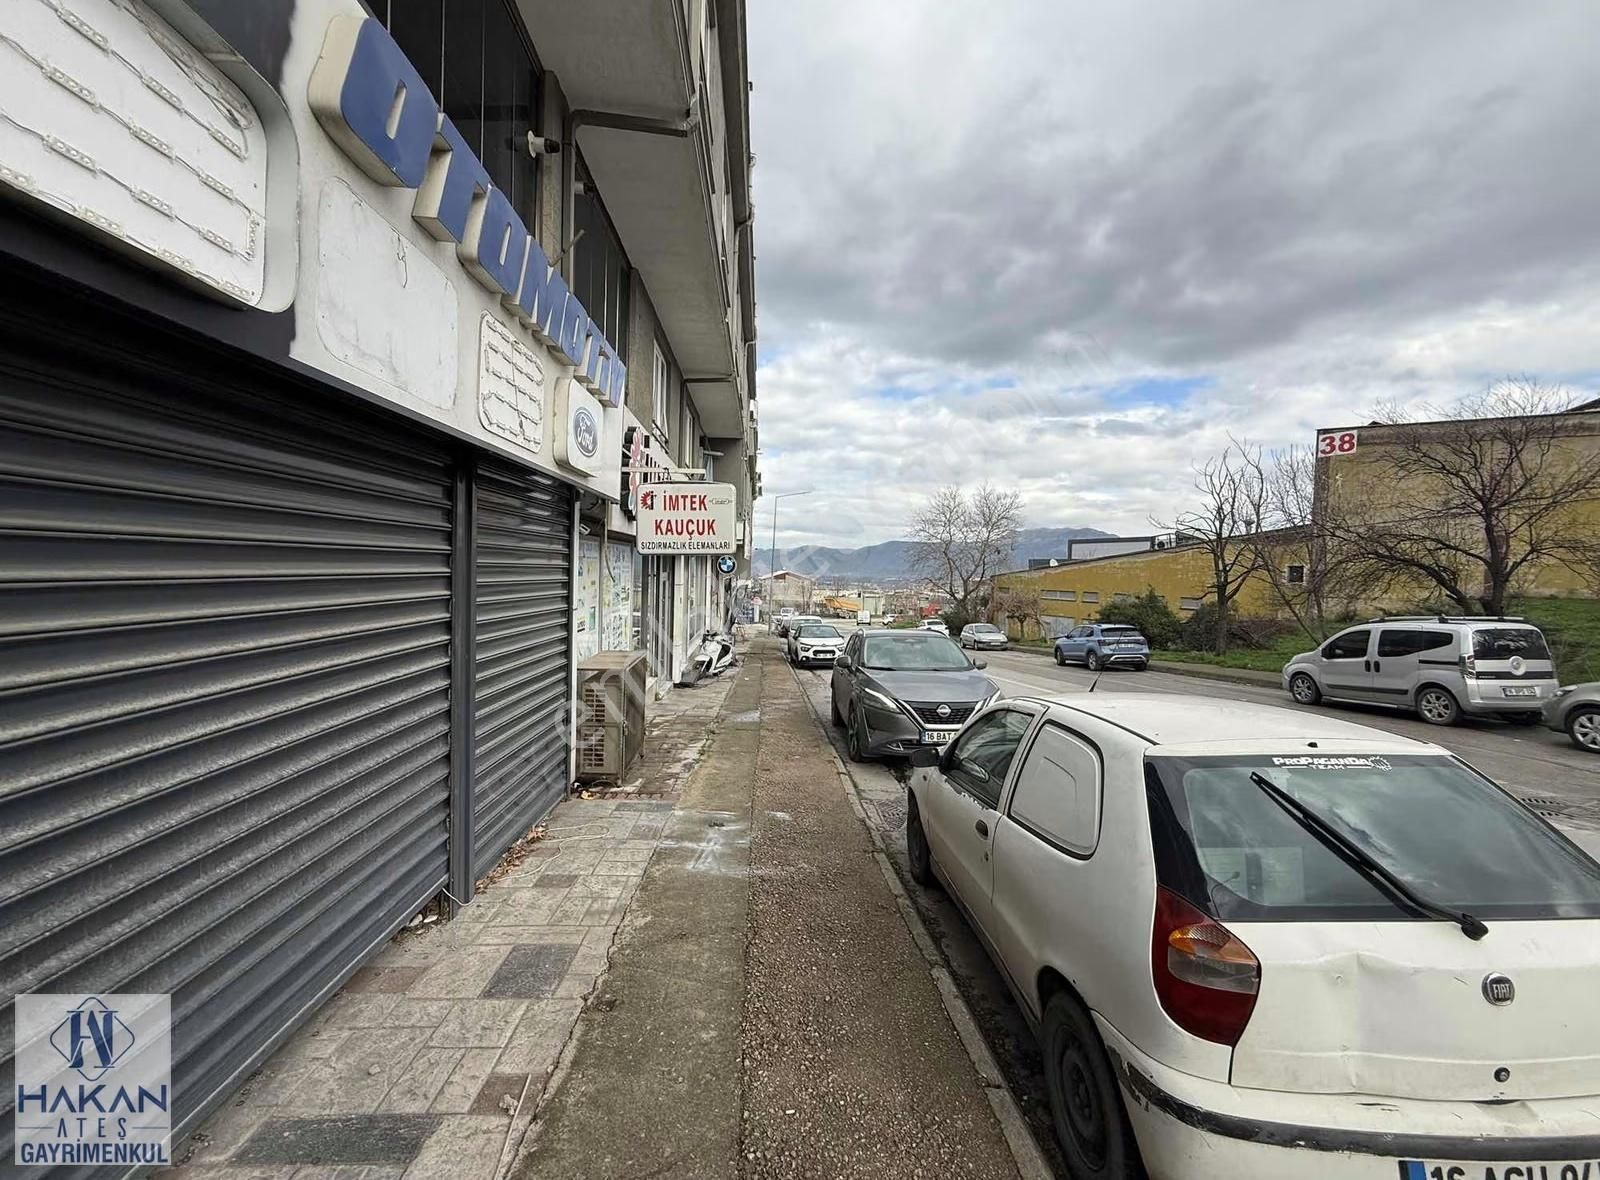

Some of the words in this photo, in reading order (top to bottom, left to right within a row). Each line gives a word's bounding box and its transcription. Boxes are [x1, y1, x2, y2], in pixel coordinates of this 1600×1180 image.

[577, 413, 595, 452] Ford
[1320, 432, 1355, 456] 38
[663, 490, 708, 511] İMTEK
[655, 518, 716, 540] KAUÇUK
[688, 541, 731, 550] ELEMANLARI
[926, 732, 935, 741] 16
[936, 732, 952, 741] BAT
[1492, 983, 1510, 999] FIAT
